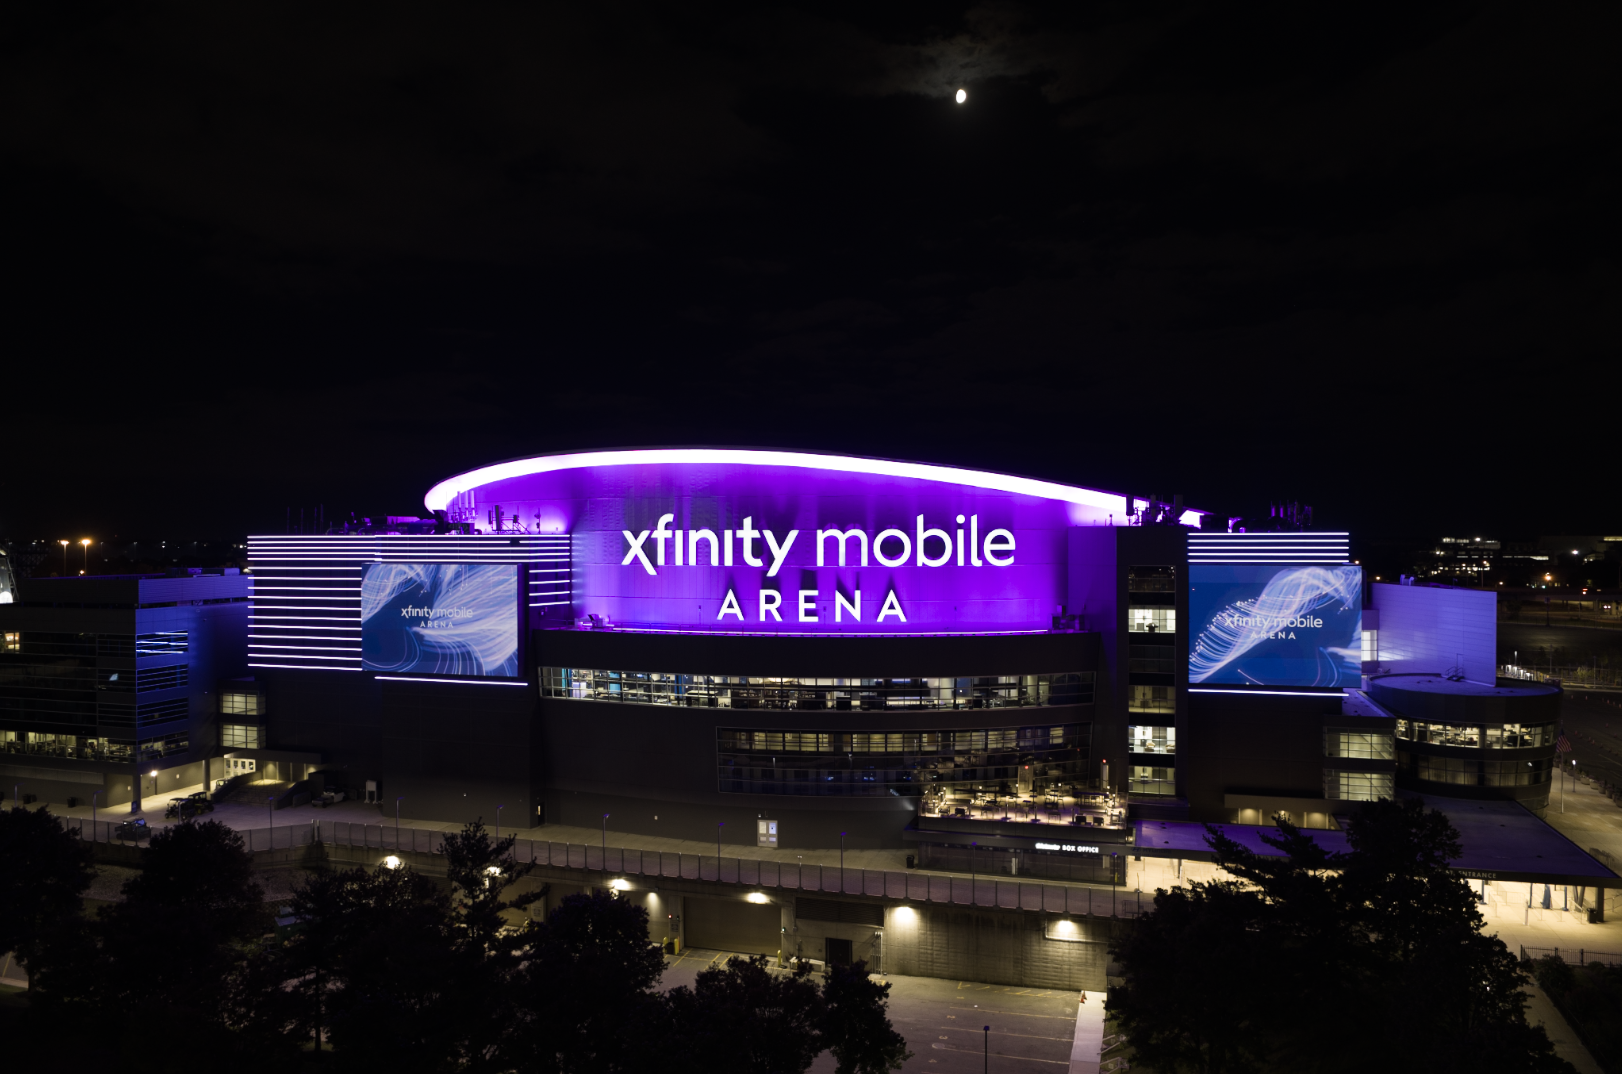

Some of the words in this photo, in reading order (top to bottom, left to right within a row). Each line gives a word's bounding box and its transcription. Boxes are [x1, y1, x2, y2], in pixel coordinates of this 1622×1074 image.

[621, 513, 799, 577] xfinity
[817, 514, 1016, 567] mobile
[401, 605, 435, 619] xfinity
[437, 606, 474, 618] mobile
[717, 588, 907, 623] ARENA
[420, 621, 454, 629] ARENA
[1224, 614, 1271, 628] xfinity
[1274, 615, 1323, 628] mobile
[1250, 631, 1296, 639] ARENA
[1062, 844, 1075, 852] BOX
[1077, 845, 1099, 853] OFFICE
